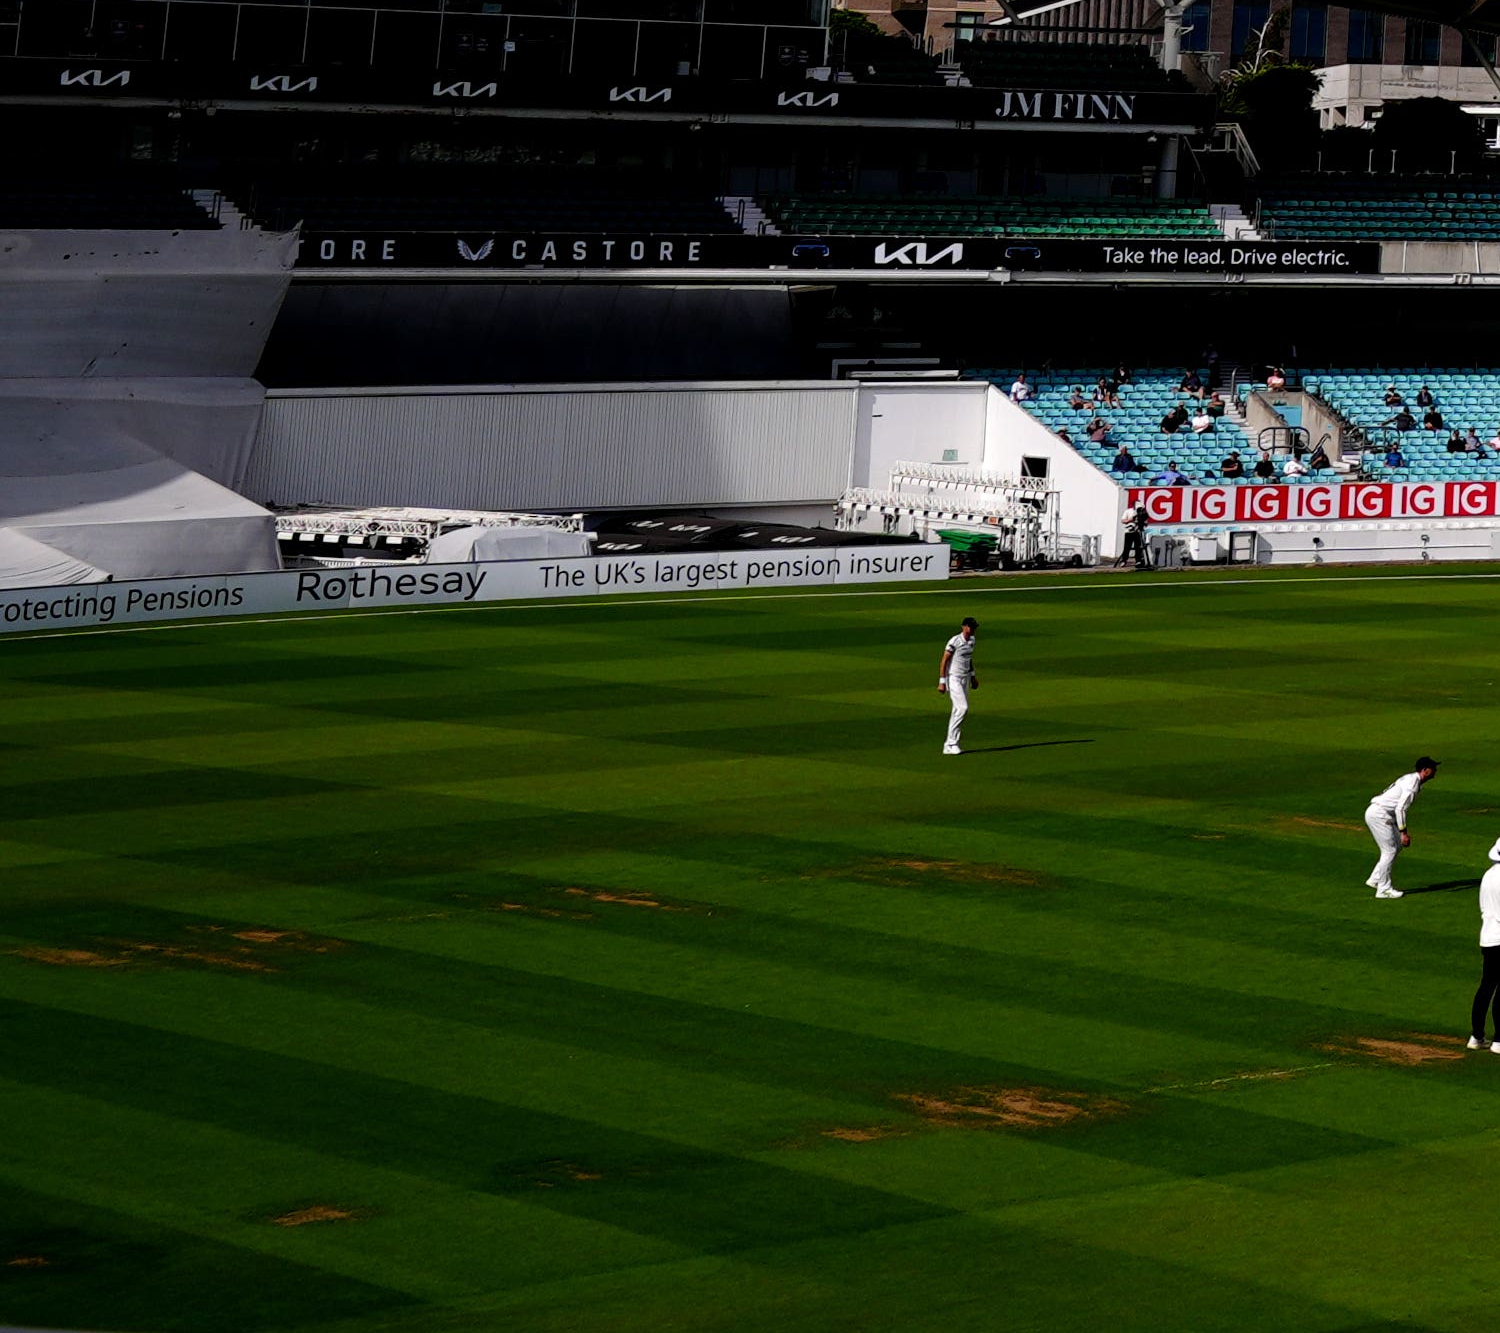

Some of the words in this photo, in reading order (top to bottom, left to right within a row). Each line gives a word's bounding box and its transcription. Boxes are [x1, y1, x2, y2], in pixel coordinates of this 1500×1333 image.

[995, 91, 1044, 119] JM
[1054, 94, 1136, 121] FINN
[512, 240, 702, 261] CASTORE
[1103, 246, 1143, 264] Take
[1149, 247, 1179, 264] the
[1183, 248, 1225, 265] lead.
[1230, 249, 1276, 266] Drive
[1281, 249, 1349, 267] electric.
[1192, 490, 1226, 520] IG
[1243, 489, 1280, 519] IG
[1302, 487, 1331, 517] IG
[1349, 485, 1385, 515] IG
[540, 566, 585, 589] The
[655, 559, 738, 589] largest
[746, 558, 840, 585] pension
[850, 553, 934, 574] insurer
[127, 584, 243, 614] Pensions
[296, 570, 487, 603] Rothesay
